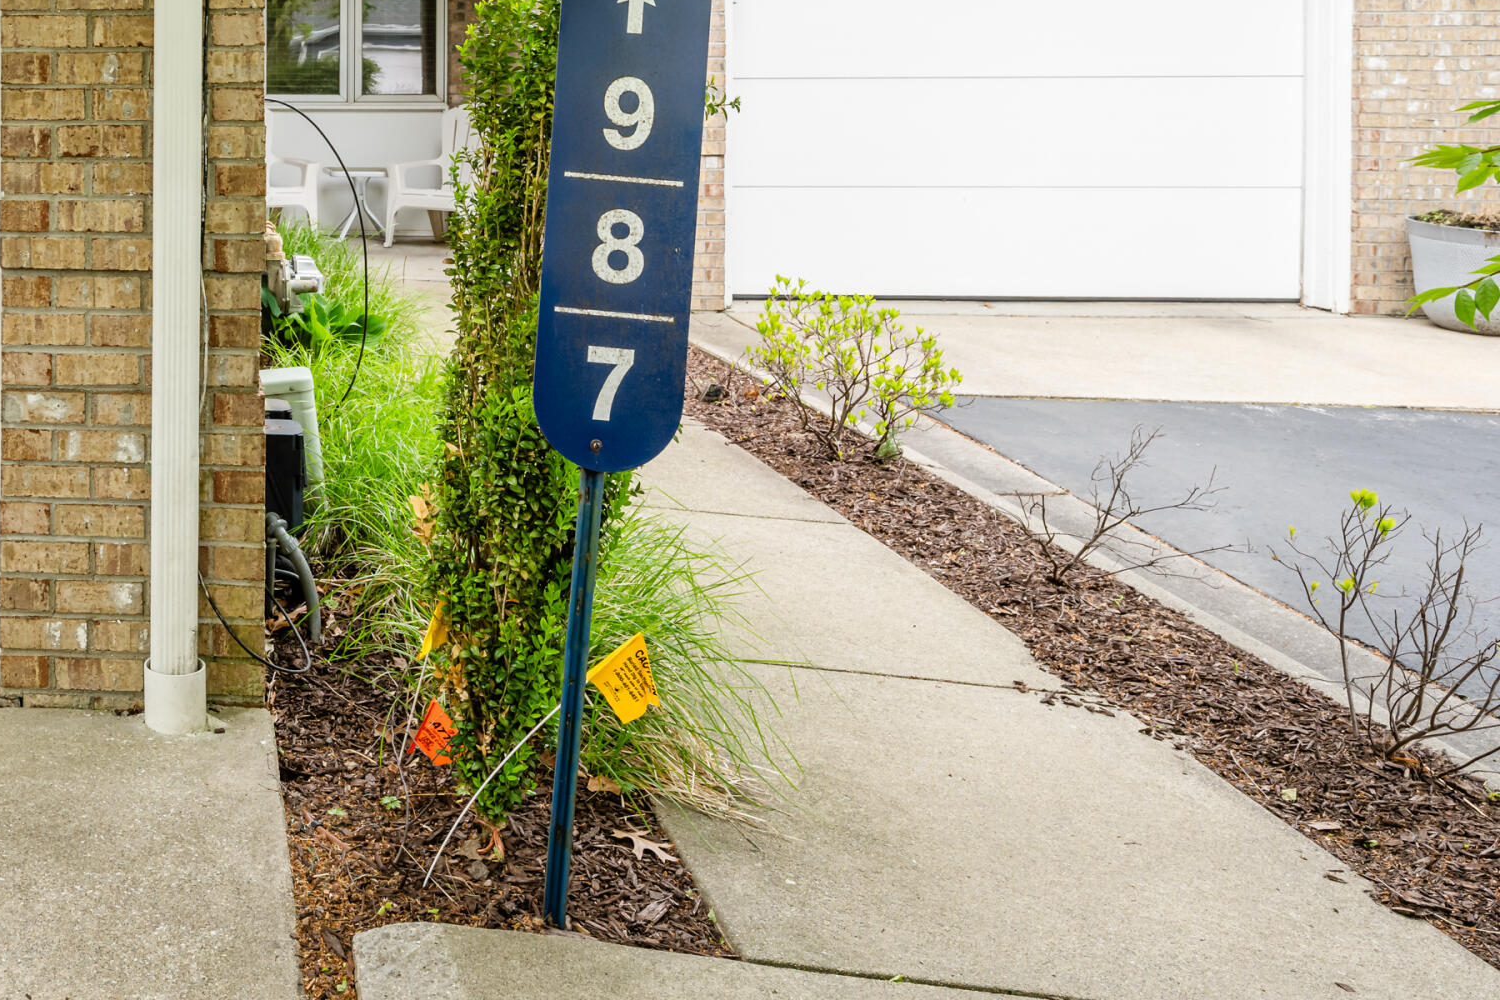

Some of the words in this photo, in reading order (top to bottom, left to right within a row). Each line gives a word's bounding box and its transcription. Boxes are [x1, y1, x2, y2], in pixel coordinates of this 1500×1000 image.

[602, 76, 654, 151] 9
[591, 208, 645, 285] 8
[586, 345, 635, 422] 7
